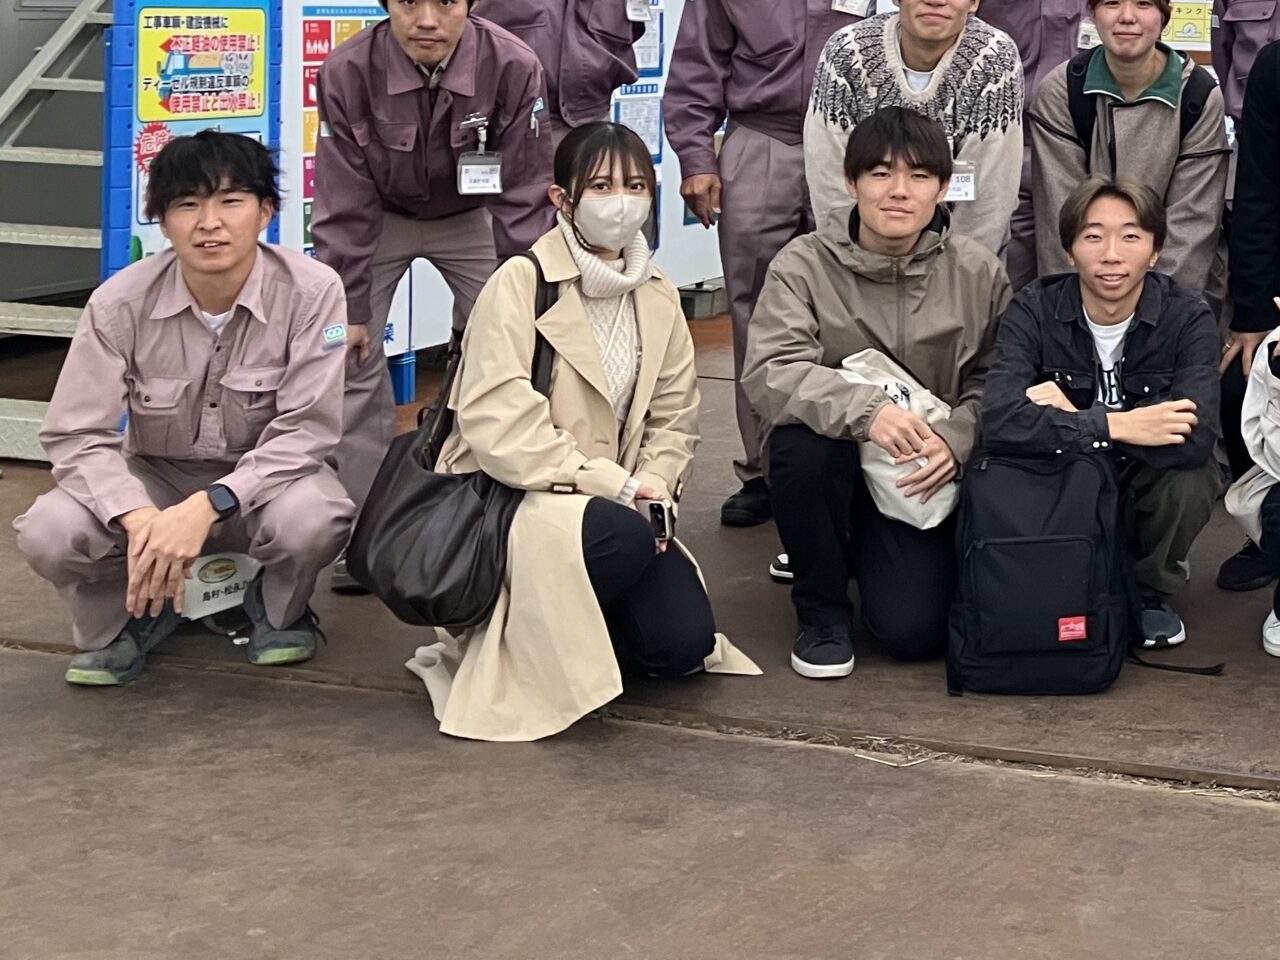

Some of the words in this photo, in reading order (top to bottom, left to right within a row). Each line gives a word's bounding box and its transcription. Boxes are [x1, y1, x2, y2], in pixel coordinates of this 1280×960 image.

[1175, 7, 1202, 15] キング
[956, 175, 971, 183] 108
